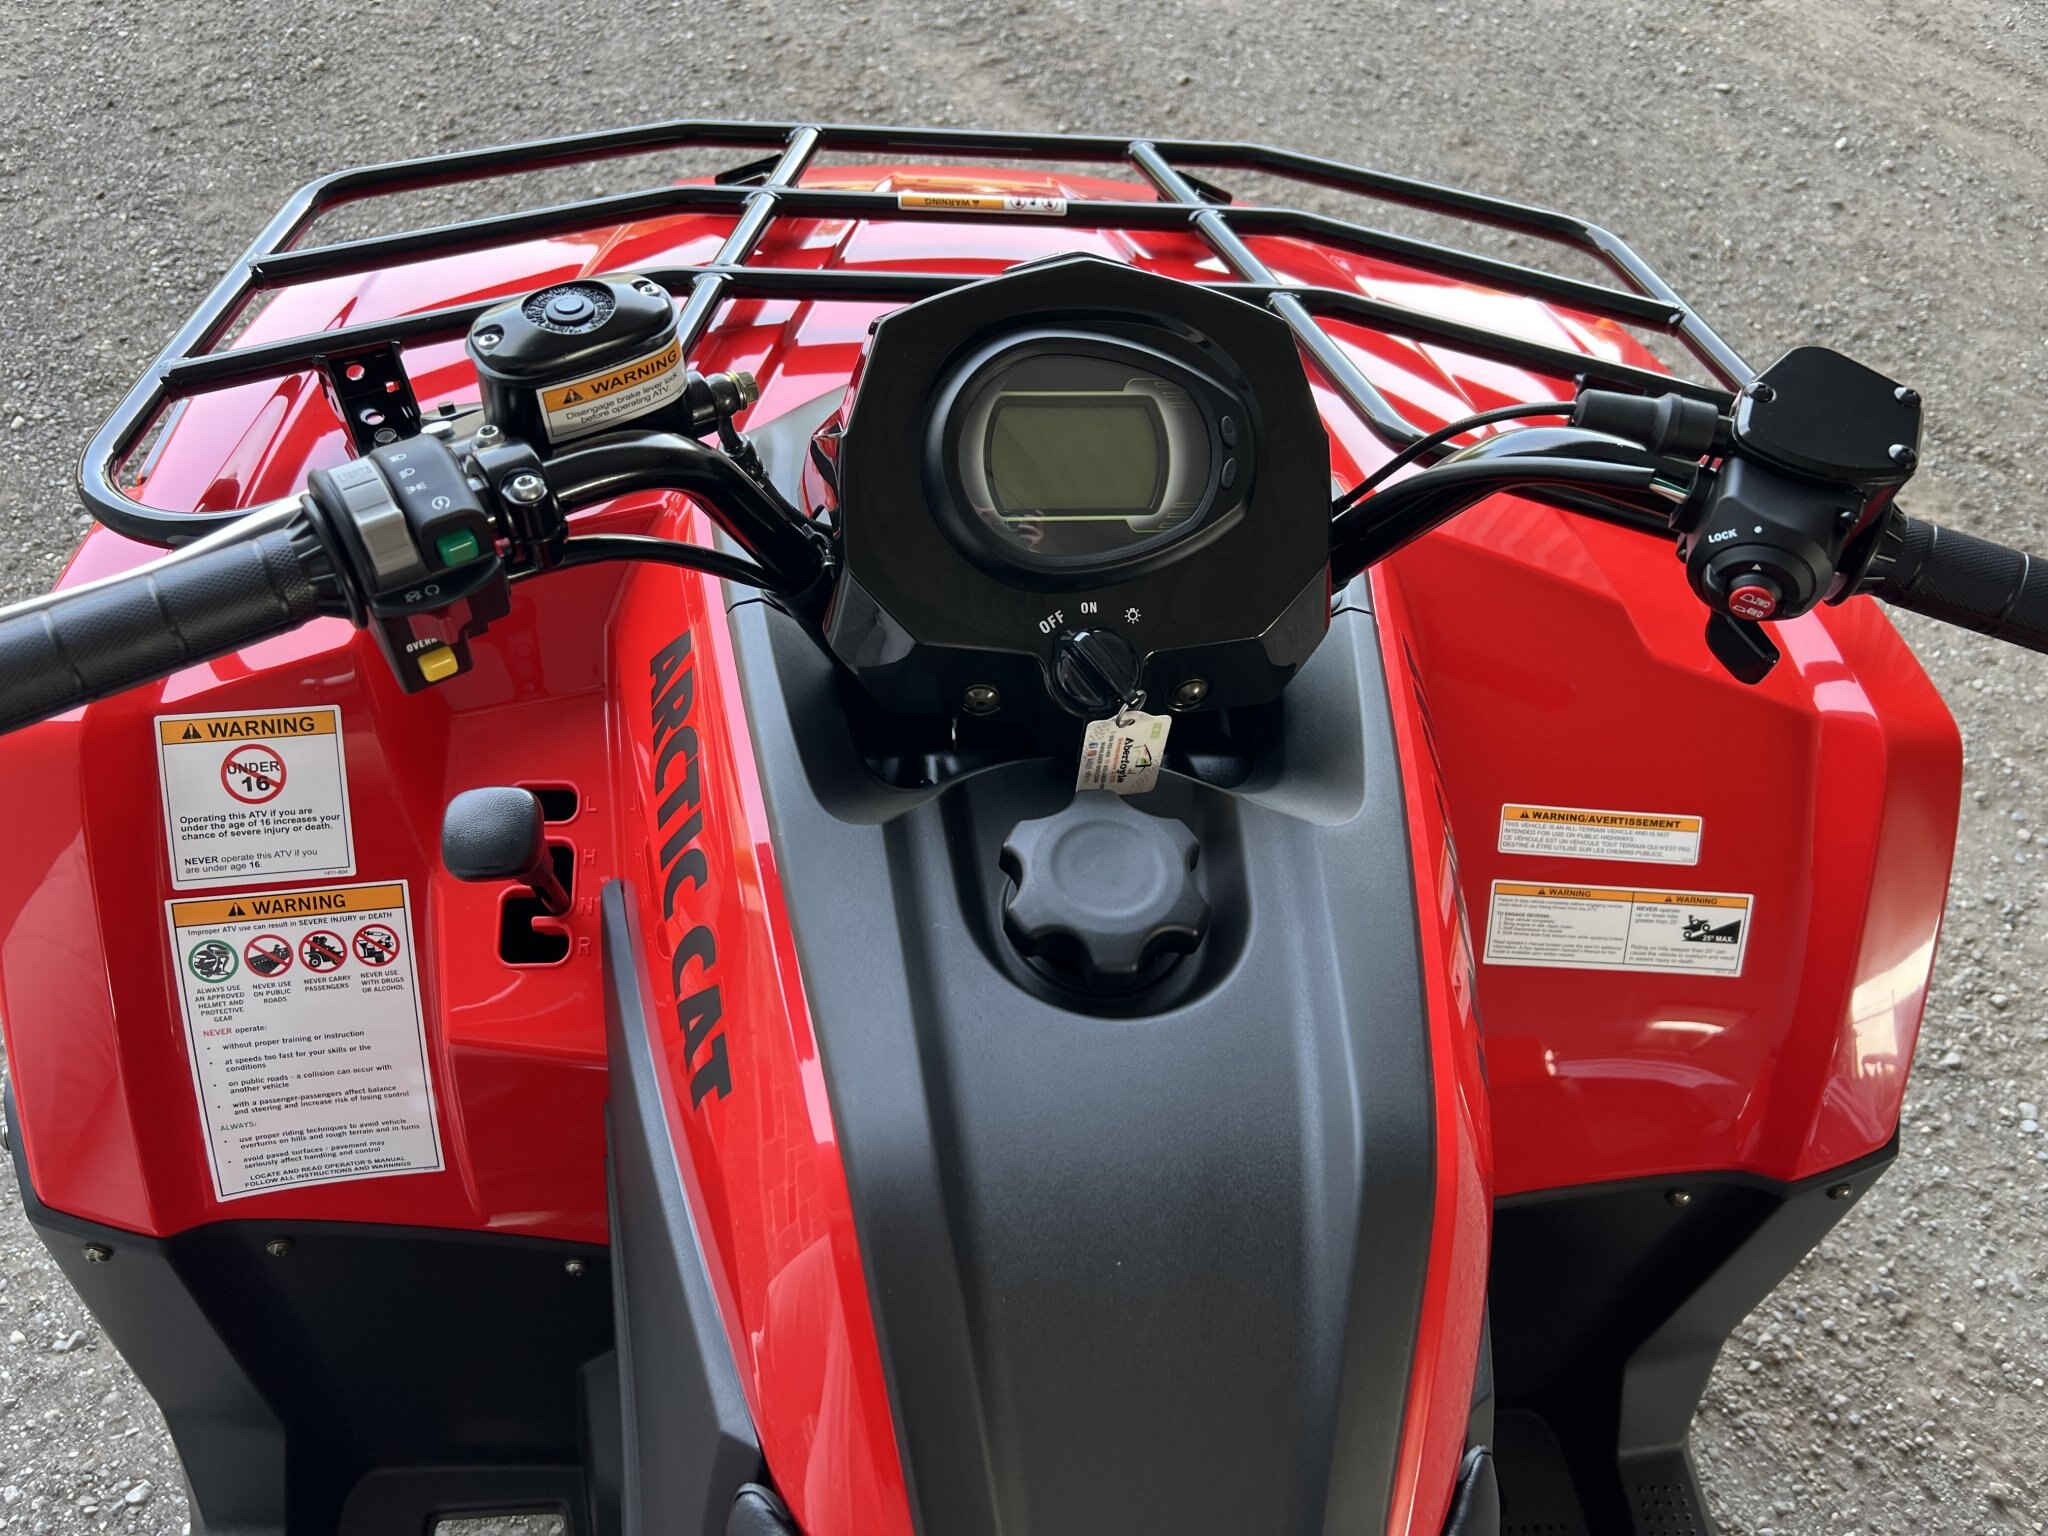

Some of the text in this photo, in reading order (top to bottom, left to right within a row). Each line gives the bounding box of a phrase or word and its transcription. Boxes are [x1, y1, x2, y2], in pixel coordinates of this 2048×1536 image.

[591, 350, 677, 394] WARNING
[566, 373, 678, 419] Disengage brake lever lock
[581, 410, 609, 424] before
[612, 396, 651, 414] operating
[1708, 529, 1738, 543] LOCK
[1081, 602, 1097, 614] ON
[1755, 598, 1770, 608] 2WD
[1747, 608, 1763, 618] 4WD
[1039, 610, 1064, 634] OFF
[208, 717, 315, 738] WARNING
[227, 761, 280, 775] UNDER
[1116, 737, 1134, 783] Aberfoyle
[241, 776, 270, 792] 16
[586, 796, 597, 811] L
[180, 814, 226, 825] Operating
[228, 812, 246, 820] this
[249, 810, 267, 818] ATV
[270, 809, 276, 817] if
[278, 810, 296, 818] you
[181, 824, 208, 832] under
[228, 822, 245, 830] age
[248, 819, 257, 827] of
[260, 818, 271, 826] 16
[273, 816, 317, 825] increases
[320, 814, 340, 823] your
[1532, 811, 1681, 829] WARNING/AVERTISSEMENT
[218, 830, 228, 838] of
[230, 829, 261, 837] severe
[264, 826, 290, 835] injury
[305, 822, 332, 831] death.
[184, 856, 218, 865] NEVER
[221, 854, 254, 863] operate
[274, 850, 292, 858] ATV
[302, 850, 318, 858] you
[584, 849, 595, 866] H
[202, 864, 228, 872] under
[230, 863, 247, 871] age
[650, 630, 732, 1112] ARCTIC CAT
[1549, 889, 1592, 898] WARNING
[1675, 896, 1718, 905] WARNING
[252, 894, 346, 915] WARNING
[581, 897, 593, 914] N
[188, 928, 220, 936] Improper
[268, 921, 288, 929] result
[298, 917, 328, 926] SEVERE
[330, 915, 357, 923] INJURY
[368, 912, 392, 920] DEATH
[578, 937, 590, 955] R
[197, 986, 225, 994] ALWAYS
[266, 988, 291, 996] PUBLIC
[305, 983, 349, 992] PASSENGERS
[373, 984, 404, 992] ALCOHOL
[207, 992, 245, 1001] APPROVED
[198, 1001, 226, 1009] HELMET
[200, 1007, 244, 1016] PROTECTIVE
[203, 1025, 267, 1037] NEVER operate:
[222, 1041, 252, 1050] without
[254, 1039, 279, 1048] proper
[282, 1036, 312, 1044] training
[324, 1030, 364, 1039] instruction
[235, 1055, 262, 1064] speeds
[328, 1046, 347, 1054] skills
[226, 1063, 266, 1072] conditions
[251, 1105, 282, 1113] steering
[301, 1099, 332, 1107] increase
[384, 1090, 409, 1099] control
[220, 1121, 256, 1131] ALWAYS:
[255, 1133, 280, 1141] proper
[282, 1130, 304, 1138] riding
[306, 1125, 347, 1133] techniques
[359, 1120, 379, 1128] avoid
[381, 1118, 407, 1126] vehicle
[245, 1178, 278, 1188] FOLLOW
[296, 1168, 352, 1179] INSTRUCTIONS
[372, 1161, 412, 1169] WARNINGS
[250, 1171, 281, 1180] LOCATE
[283, 1168, 300, 1176] AND
[374, 1156, 405, 1164] MANUAL
